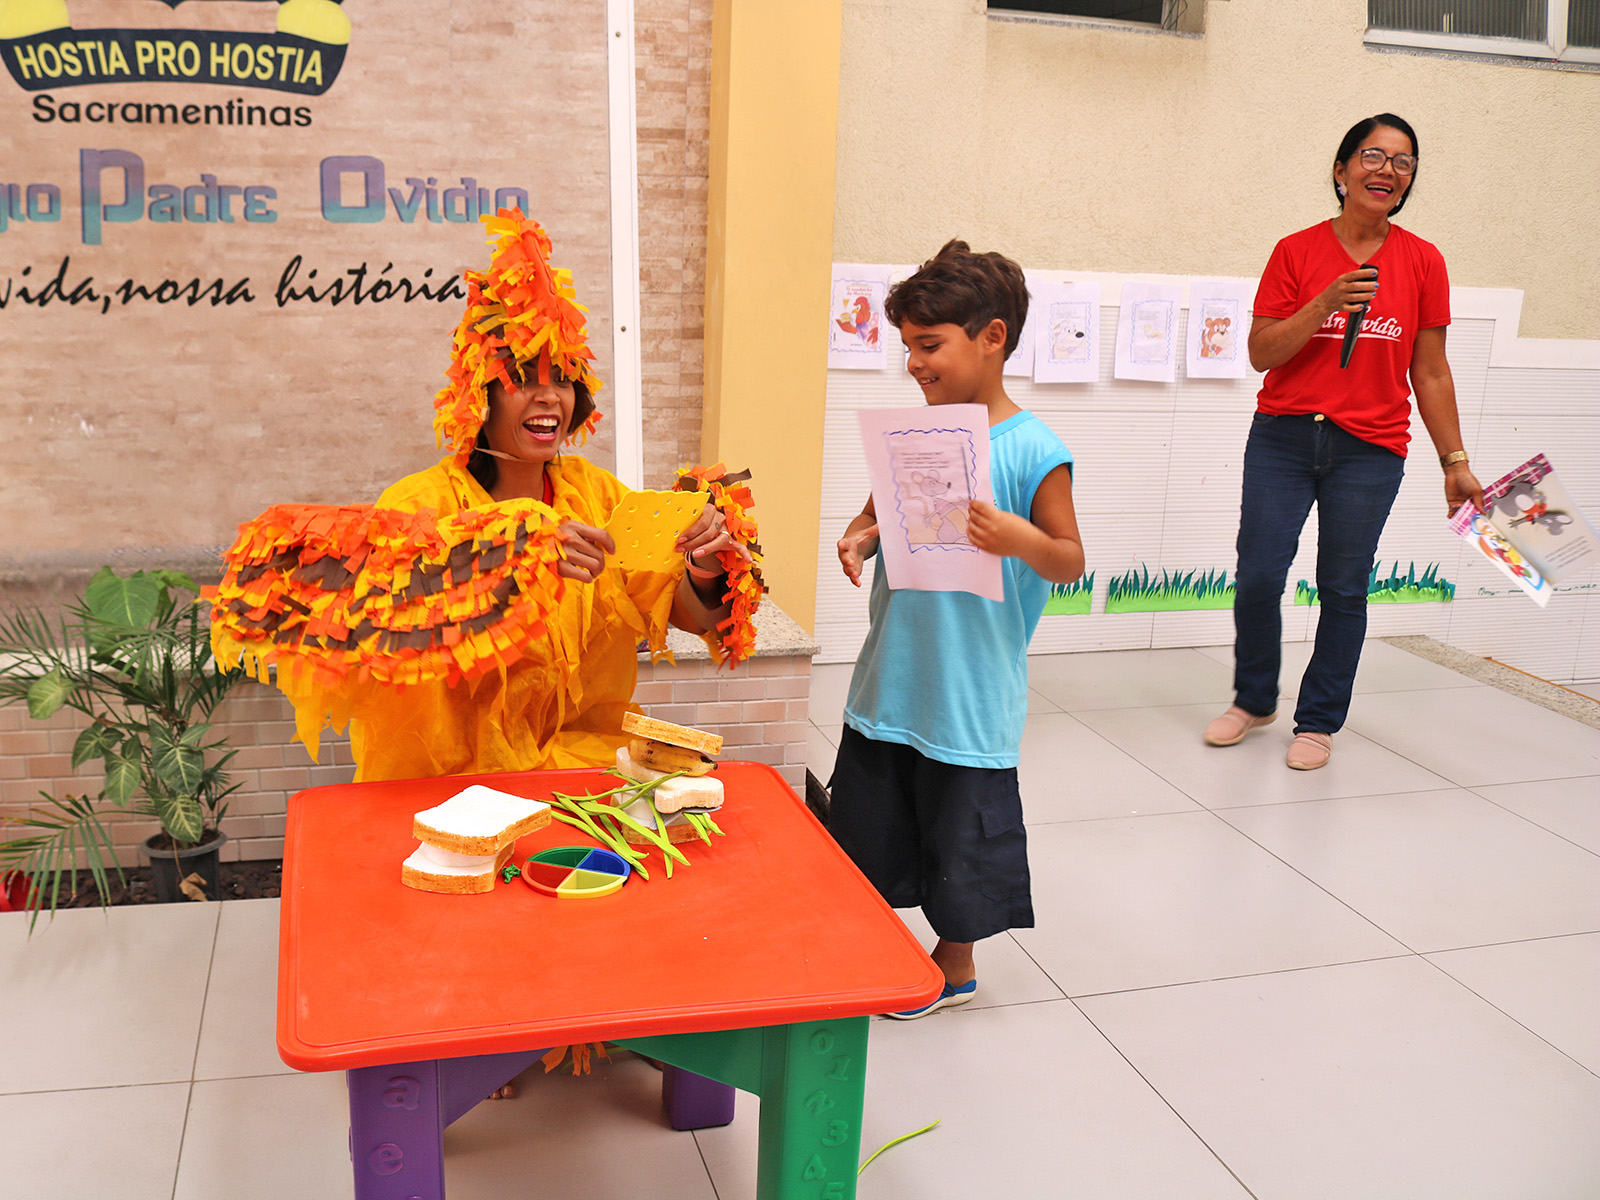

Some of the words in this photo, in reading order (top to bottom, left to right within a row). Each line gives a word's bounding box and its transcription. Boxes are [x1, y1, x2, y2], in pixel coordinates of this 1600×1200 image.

[13, 40, 131, 79] HOSTIA
[135, 40, 201, 77] PRO
[210, 42, 323, 86] HOSTIA
[32, 94, 312, 127] Sacramentinas
[79, 148, 278, 245] Padre
[275, 254, 466, 308] história
[1321, 310, 1346, 329] dre
[1361, 314, 1403, 338] vídio
[382, 1075, 421, 1111] a
[821, 1119, 849, 1147] 3
[368, 1142, 404, 1176] e
[802, 1152, 827, 1181] 4
